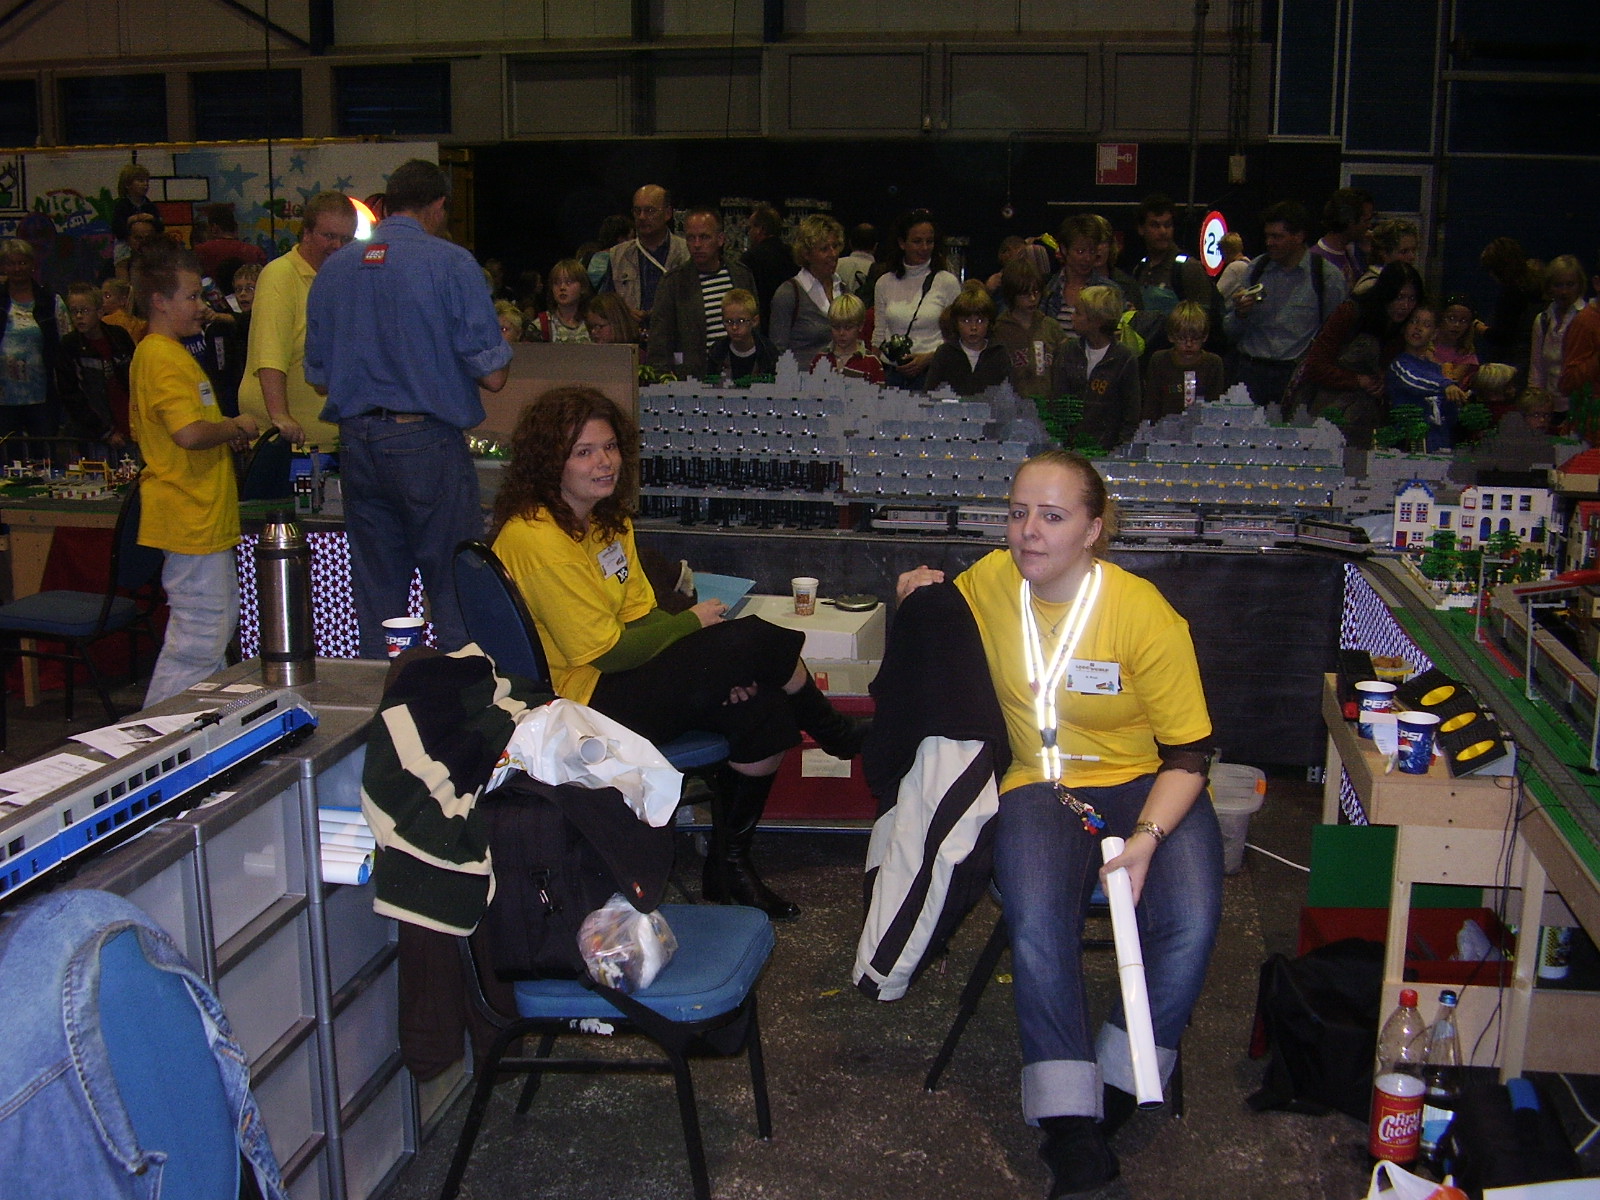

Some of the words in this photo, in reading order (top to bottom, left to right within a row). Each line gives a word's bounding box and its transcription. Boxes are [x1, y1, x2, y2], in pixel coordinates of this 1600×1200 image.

[365, 249, 386, 259] LEGO
[385, 635, 412, 646] EPSI
[1363, 699, 1395, 709] PEP
[1397, 730, 1424, 742] EPSI
[1395, 1110, 1420, 1127] First
[1378, 1115, 1419, 1142] Choice
